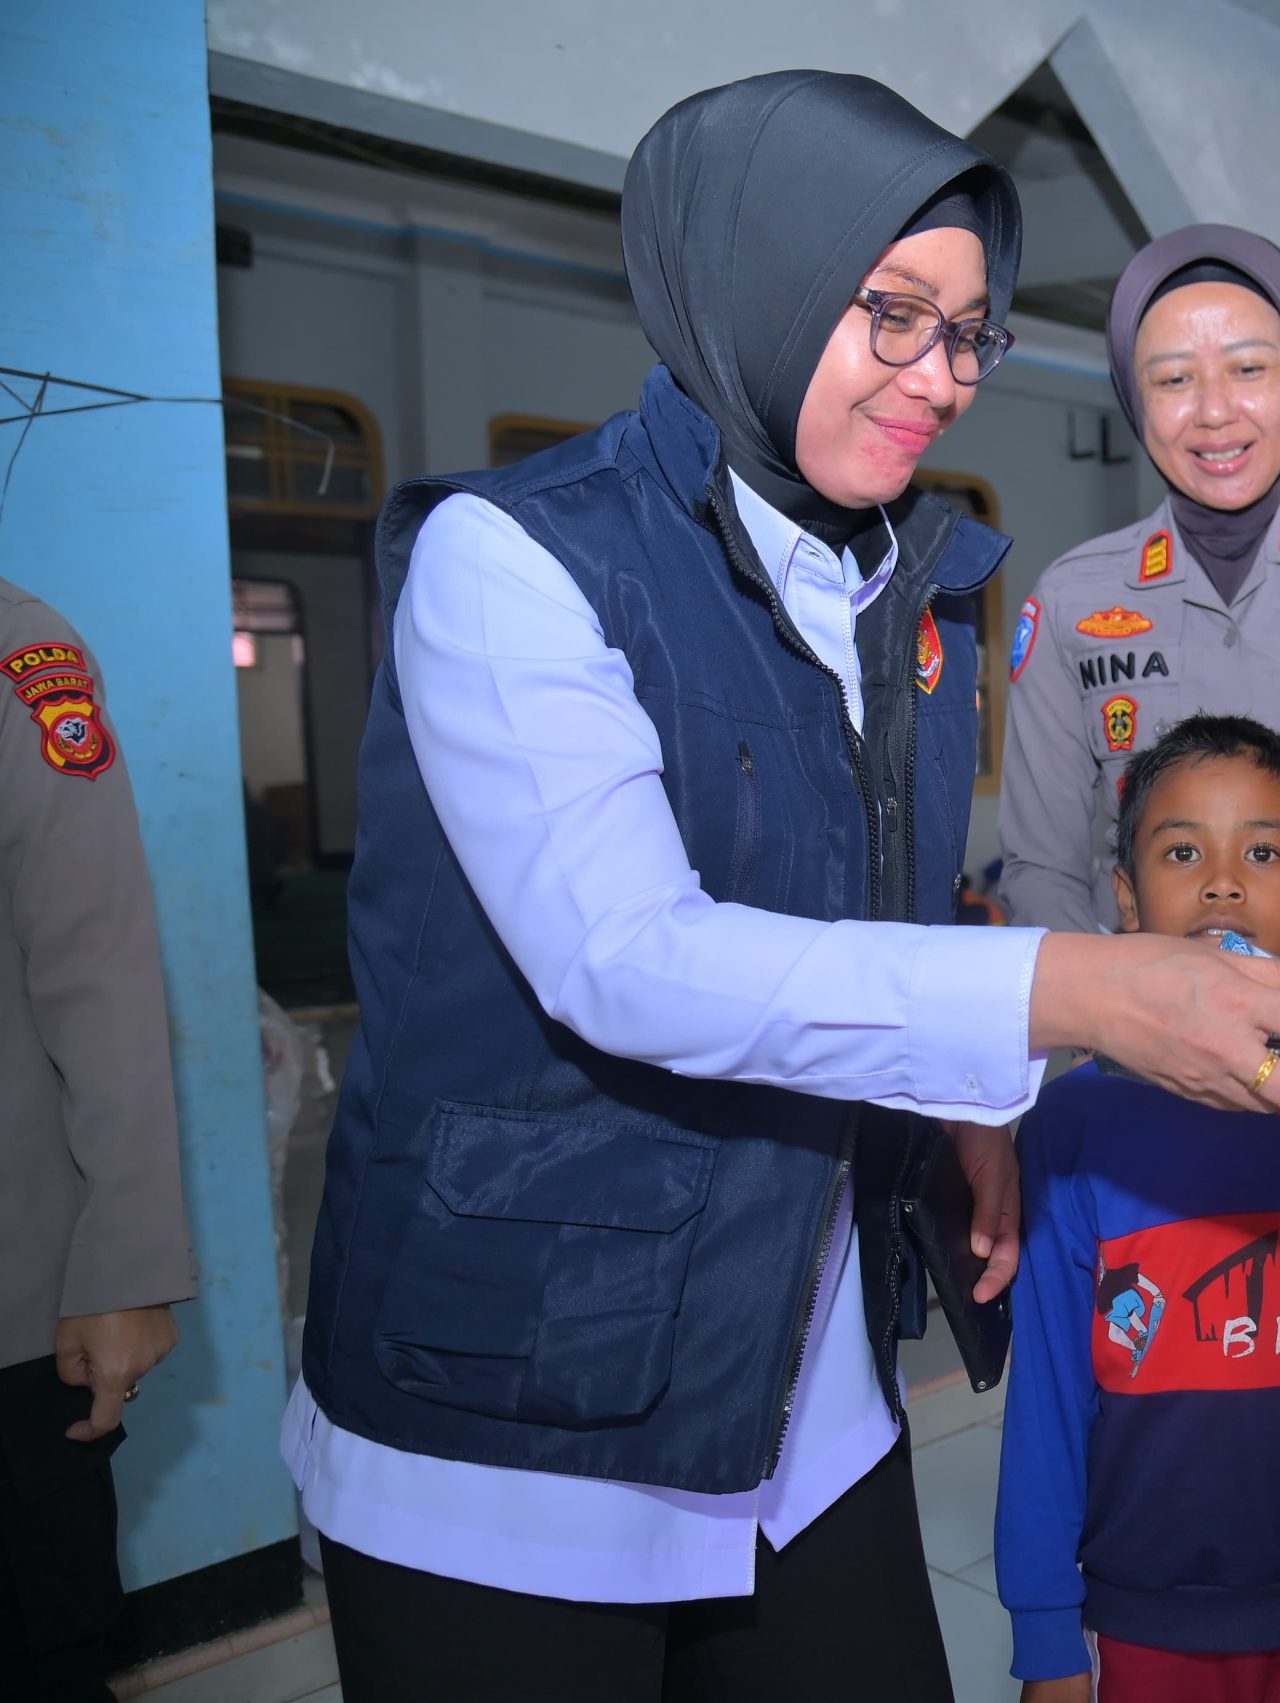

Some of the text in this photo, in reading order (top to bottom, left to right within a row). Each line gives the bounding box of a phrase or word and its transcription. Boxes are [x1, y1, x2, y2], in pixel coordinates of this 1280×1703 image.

[9, 647, 79, 673] POLDA
[1079, 651, 1170, 690] NINA
[25, 677, 88, 699] JAWA BARAT
